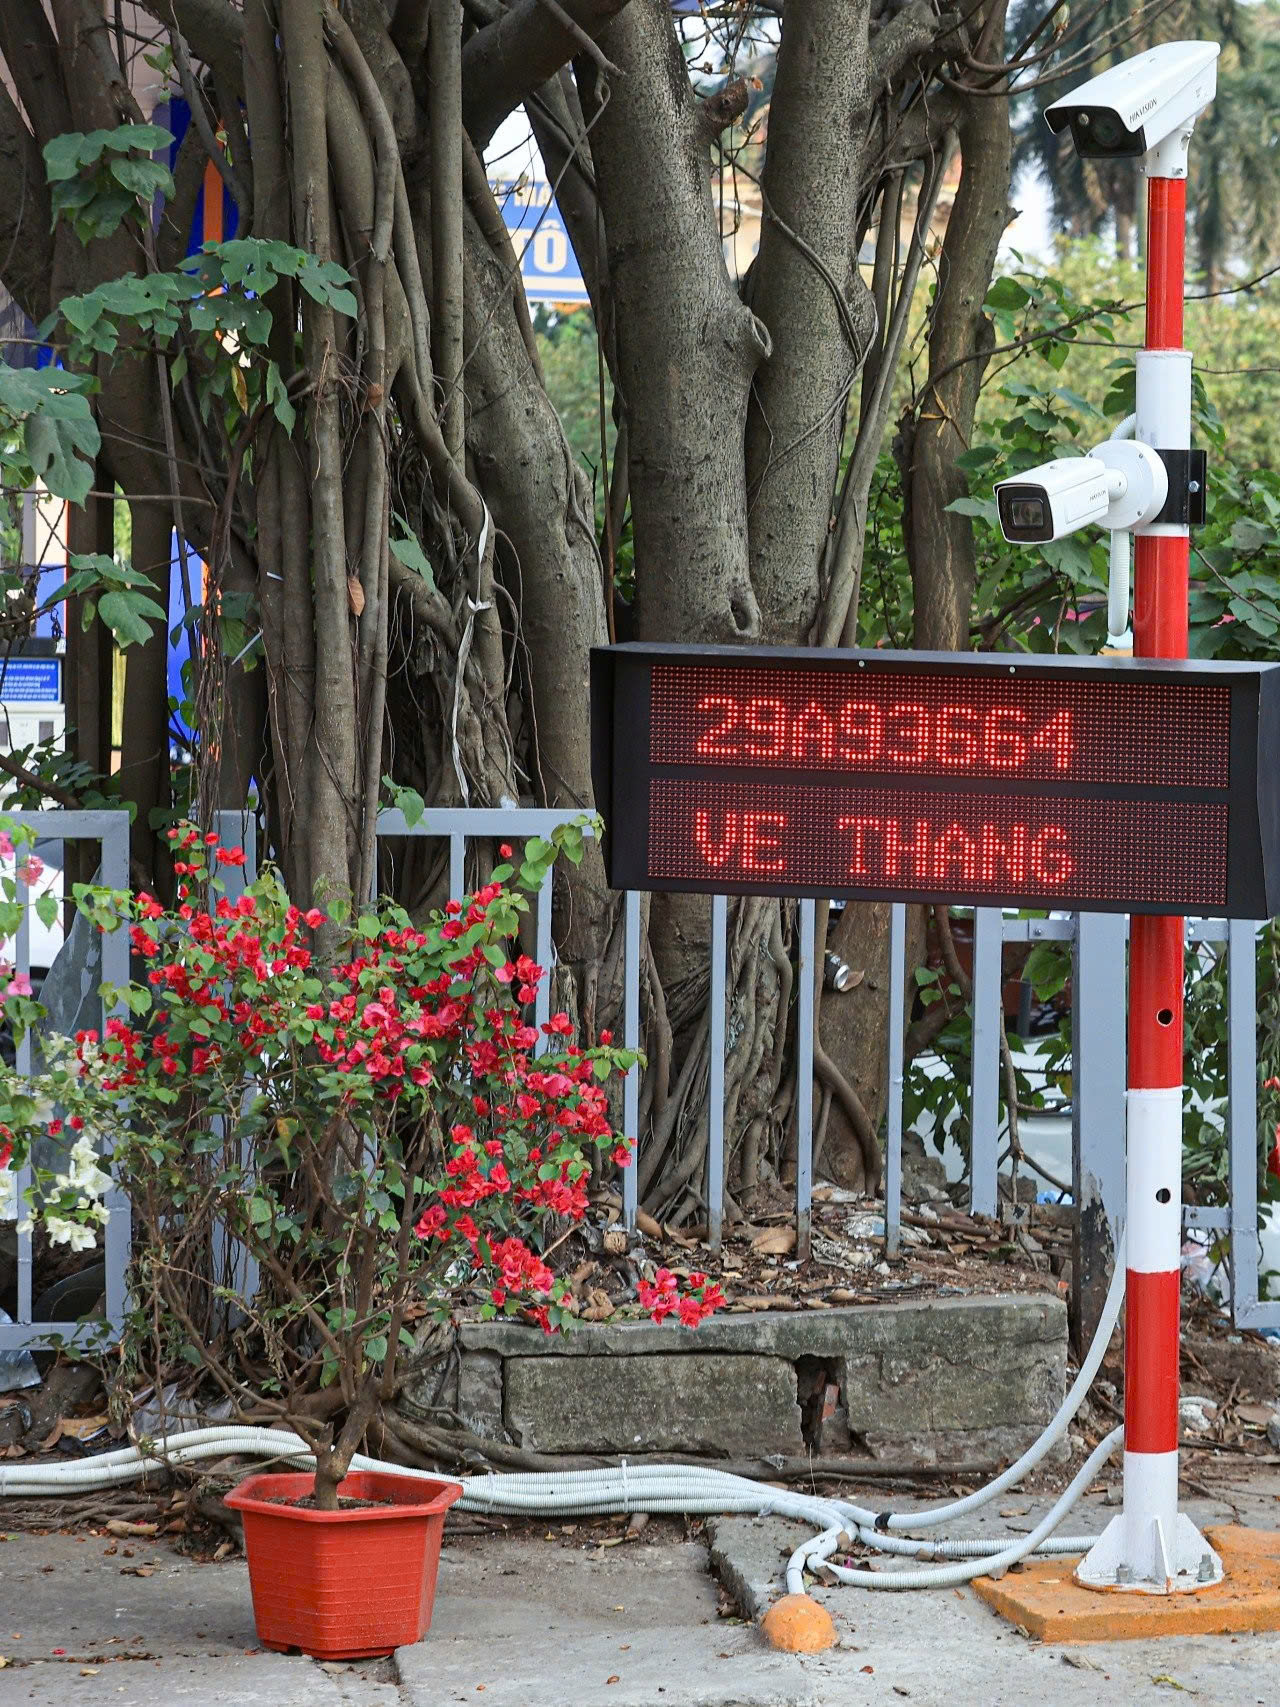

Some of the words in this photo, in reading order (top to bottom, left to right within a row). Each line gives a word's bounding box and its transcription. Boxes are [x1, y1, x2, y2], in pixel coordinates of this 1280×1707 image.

[696, 696, 1076, 770] 29A93664
[694, 809, 787, 873] VE
[837, 816, 1074, 885] THANG
